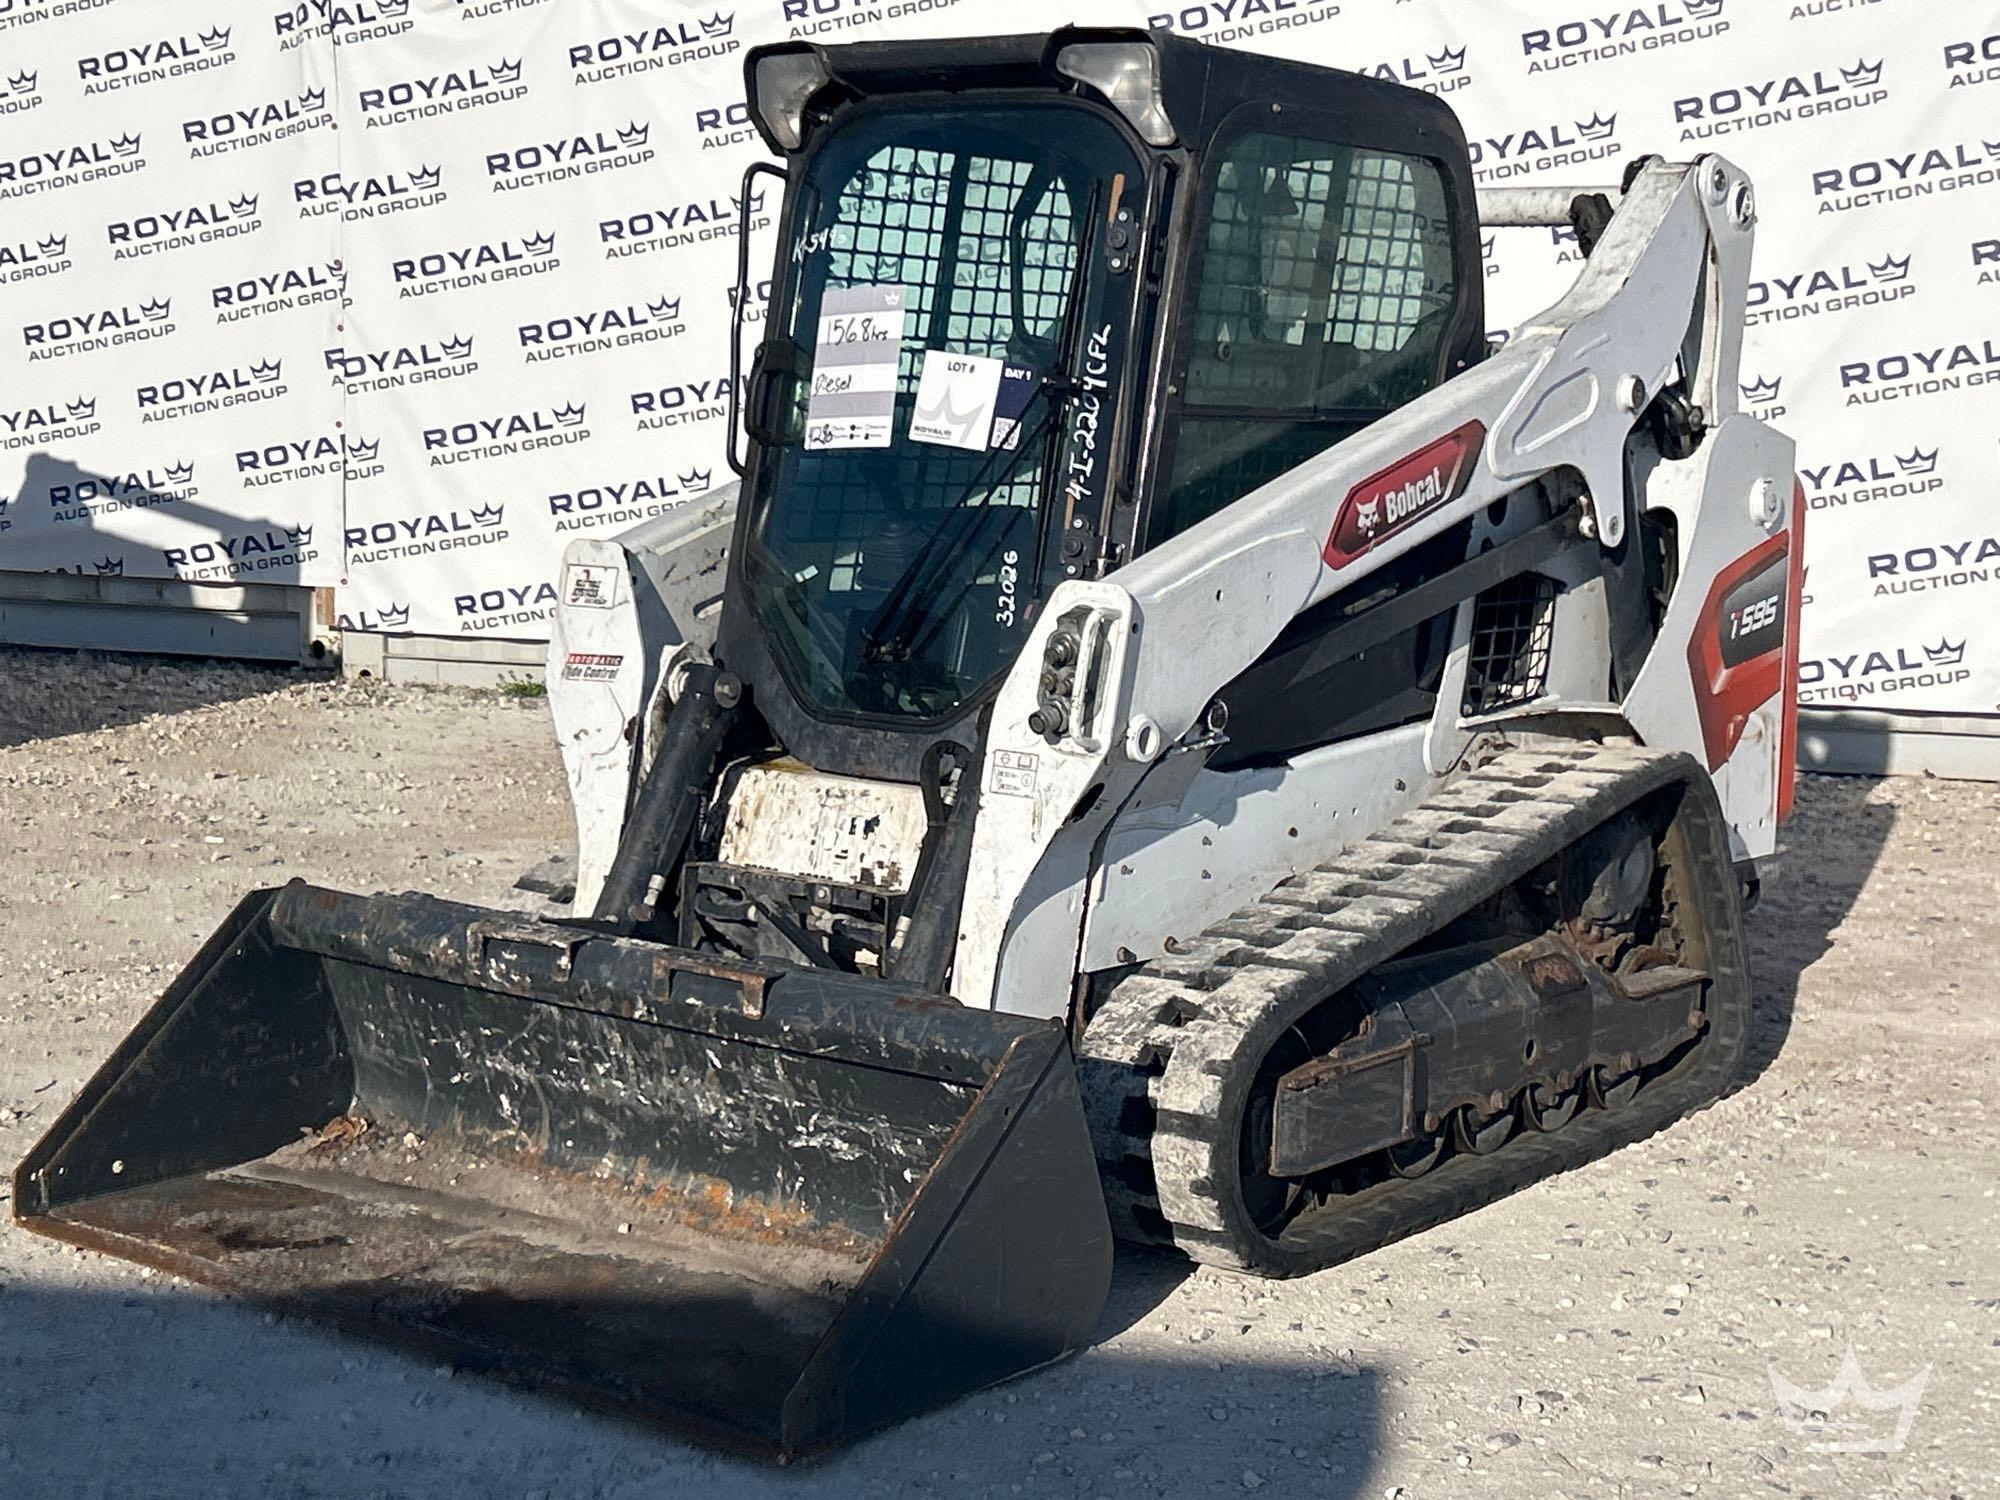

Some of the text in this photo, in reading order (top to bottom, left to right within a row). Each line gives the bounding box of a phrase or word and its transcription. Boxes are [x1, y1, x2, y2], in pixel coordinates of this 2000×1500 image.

[0, 9, 48, 30] CTION
[53, 0, 115, 17] GROU
[345, 20, 414, 44] GROUP
[789, 9, 882, 39] AUCTION
[1259, 6, 1340, 34] GROUP
[1522, 4, 1682, 56] ROYAL
[78, 37, 200, 79] ROYAL
[569, 23, 700, 68] ROYAL
[576, 40, 739, 85] AUCTION GROUP
[1528, 22, 1729, 74] AUCTION GROUP
[85, 53, 235, 96] AUCTION GROUP
[360, 69, 488, 112] ROYAL
[366, 86, 528, 129] AUCTION GROUP
[1674, 72, 1839, 123] ROYAL
[1680, 90, 1887, 142] AUCTION GROUP
[183, 100, 299, 143] ROYAL
[191, 114, 333, 159] AUCTION GROUP
[0, 143, 111, 183] ROYAL
[486, 133, 617, 176] ROYAL
[493, 150, 654, 192] AUCTION GROUP
[1536, 143, 1621, 170] GROUP
[1813, 145, 1982, 195] ROYAL
[0, 159, 145, 199] AUCTION GROUP
[1819, 182, 1932, 214] AUCTION
[108, 204, 229, 244] ROYAL
[300, 192, 447, 222] AUCION GROUP
[599, 200, 731, 242] ROYAL
[115, 220, 261, 260] AUCTION GROUP
[606, 232, 694, 259] AUCTION
[11, 260, 71, 281] GROUP
[393, 242, 523, 282] ROYAL
[400, 259, 560, 299] AUCTION GROUP
[212, 267, 327, 308] ROYAL
[1744, 285, 1915, 326] CTION GROUP
[1746, 267, 1867, 306] OYAL
[217, 288, 353, 324] AUCTION GROP
[23, 307, 140, 345] ROYAL
[29, 324, 175, 362] AUCTION GROUP
[518, 306, 648, 347] ROYAL
[526, 324, 685, 363] AUCTION GROUP
[331, 362, 478, 395] ACTION GROUP
[947, 361, 967, 373] LOT
[1004, 367, 1025, 379] DAY
[137, 369, 250, 407] ROYAL
[142, 385, 287, 423] AUCTION GROUP
[1847, 377, 1960, 406] AUCTION
[0, 406, 67, 432] YAL
[39, 423, 101, 443] GROUP
[423, 412, 553, 450] ROYAL
[637, 406, 725, 431] AUCTION
[431, 430, 590, 466] AUCTION GROUP
[50, 470, 165, 506] ROYAL
[244, 461, 384, 488] AUCTION GOUP
[1800, 458, 1895, 490] YAL
[1854, 479, 1943, 502] GROUP
[54, 487, 198, 522] AUCTION GROUP
[549, 478, 678, 515] ROYAL
[1385, 466, 1441, 524] Bobcat
[345, 512, 472, 548] ROYAL
[556, 508, 642, 532] AUCTION
[162, 532, 286, 568] ROYAL
[257, 550, 318, 569] GROUP
[351, 530, 509, 565] AUCTION GROUP
[1868, 538, 2000, 578] ROYA
[455, 583, 558, 616] ROYA
[996, 550, 1018, 627] 32026
[1875, 569, 1987, 596] AUCTION
[462, 609, 545, 631] AUCTION
[1731, 594, 1778, 640] T595
[1798, 648, 1922, 684] OYAL
[1798, 669, 1970, 703] CTION GROUP
